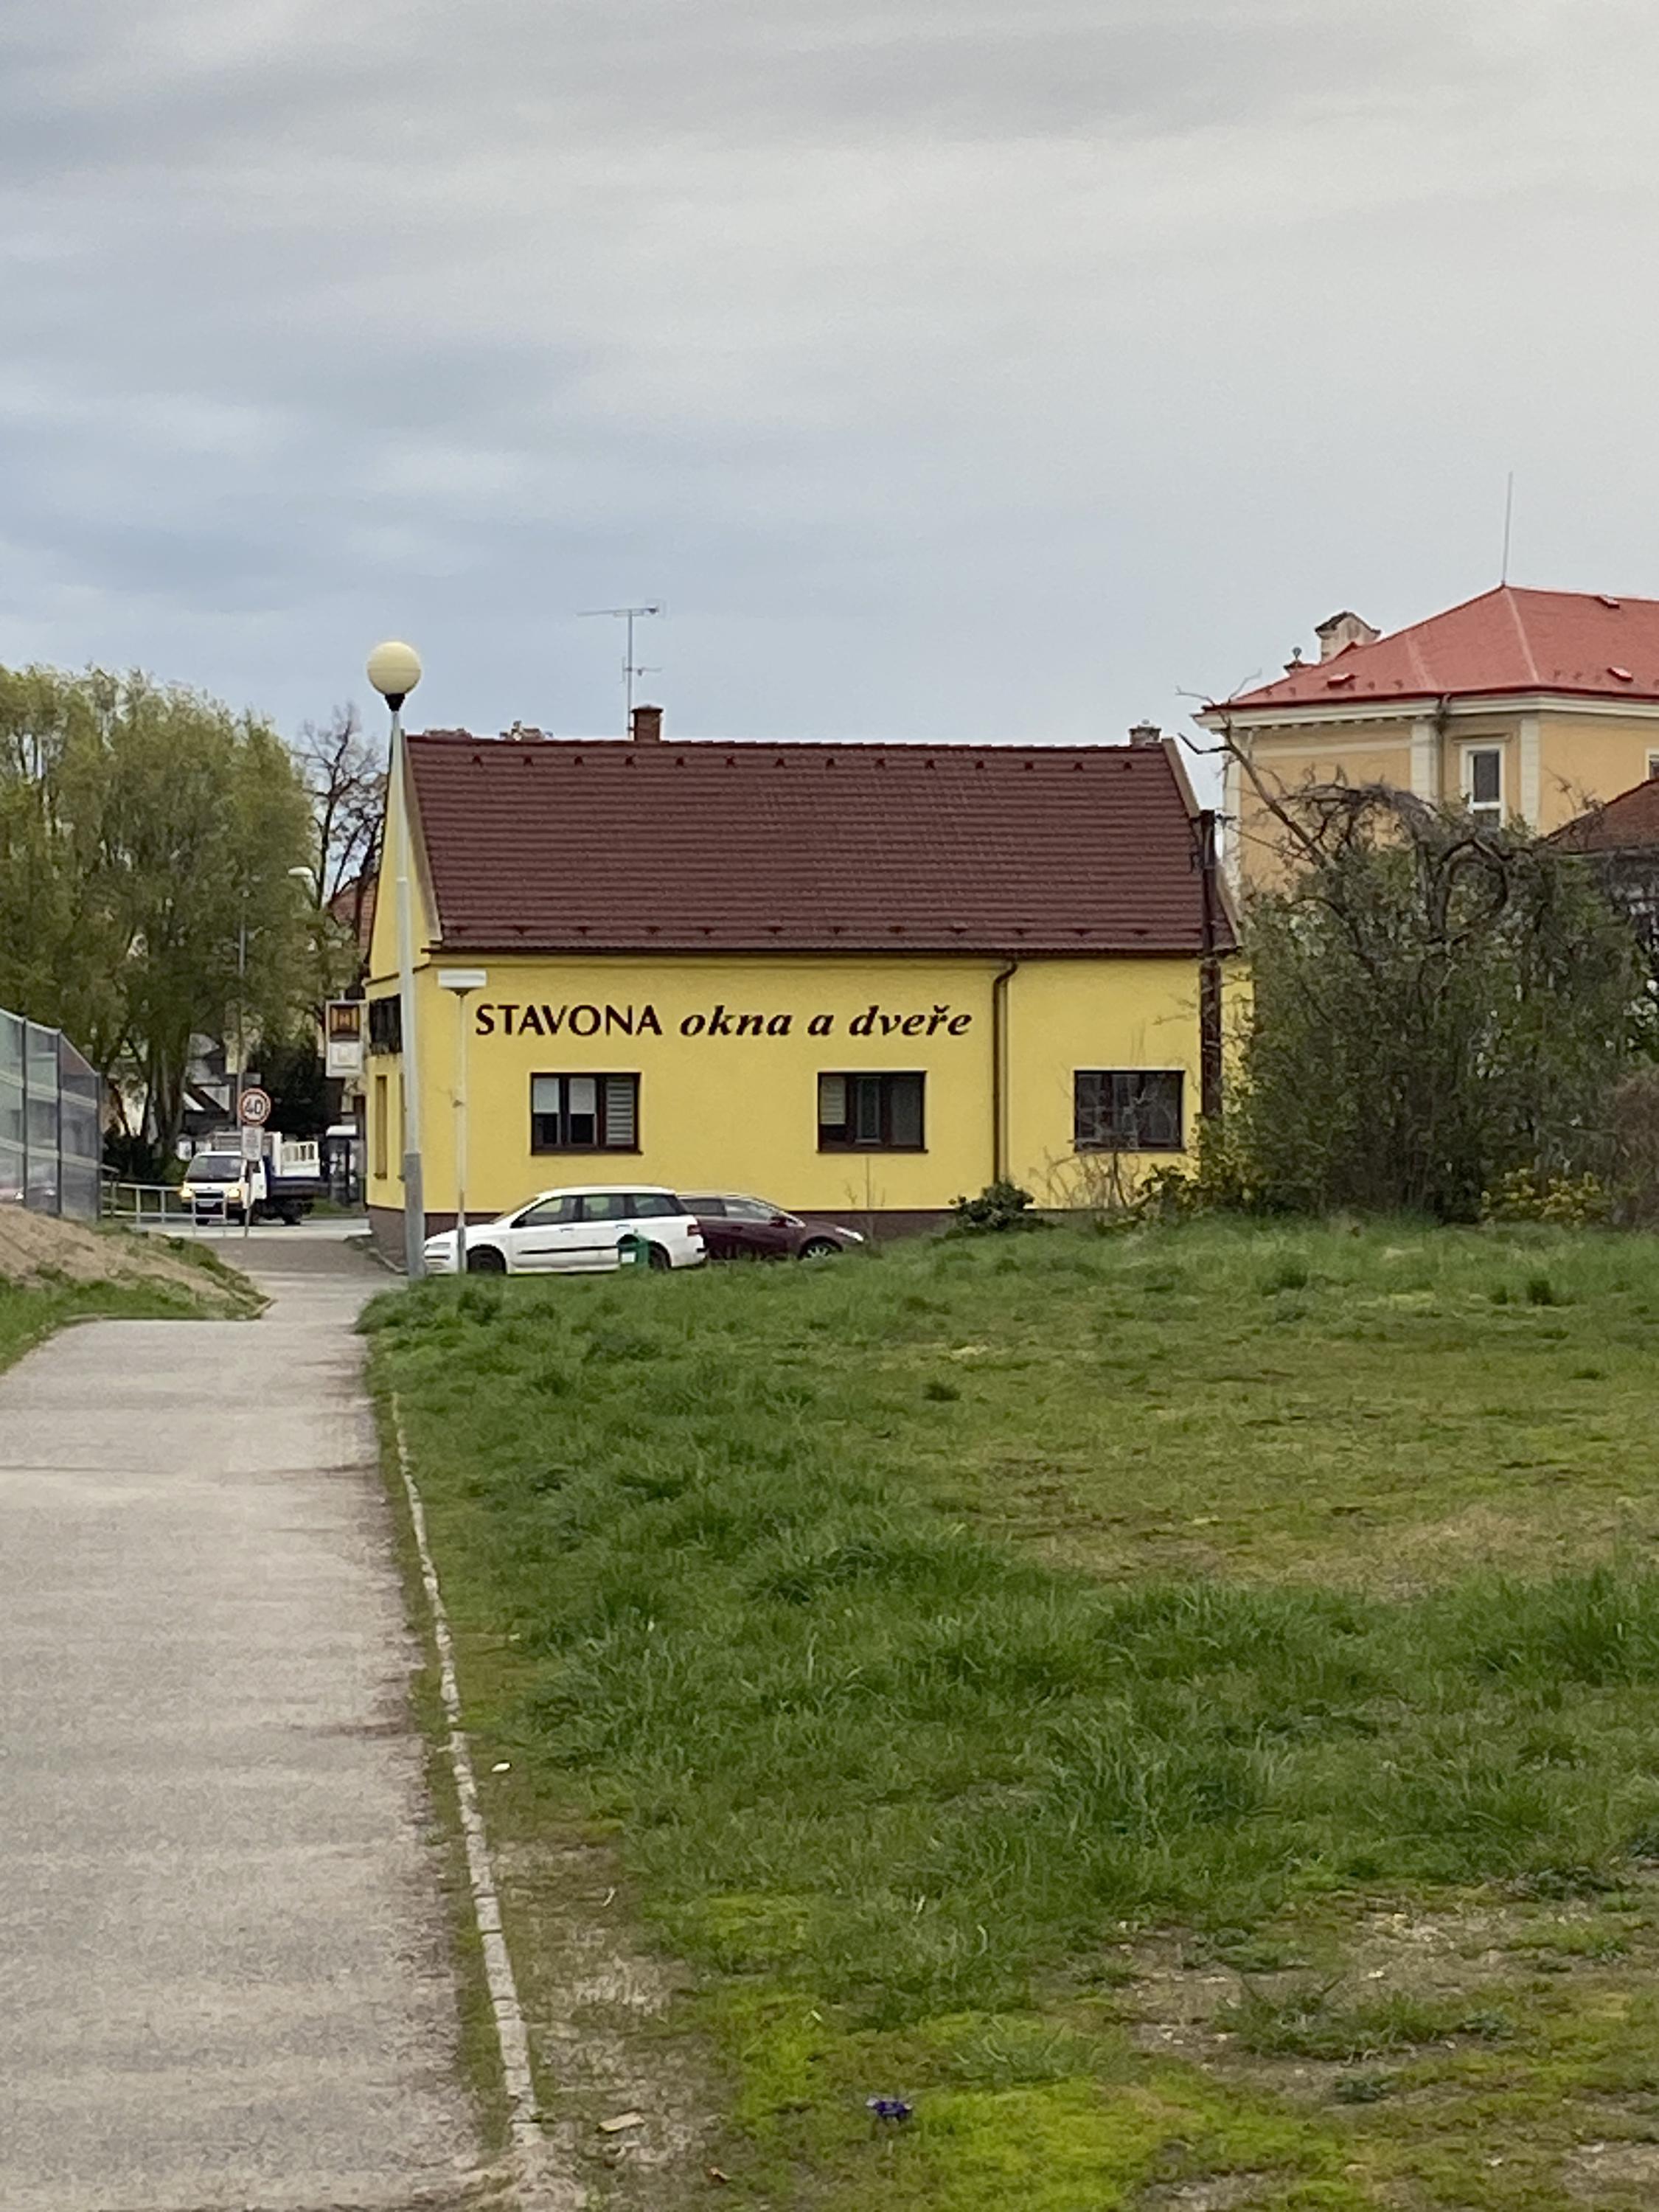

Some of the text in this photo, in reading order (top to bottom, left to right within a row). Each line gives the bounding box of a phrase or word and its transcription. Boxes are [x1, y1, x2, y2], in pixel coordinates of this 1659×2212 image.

[476, 1004, 973, 1037] STAVONA okna a dveře
[245, 1098, 263, 1114] 40
